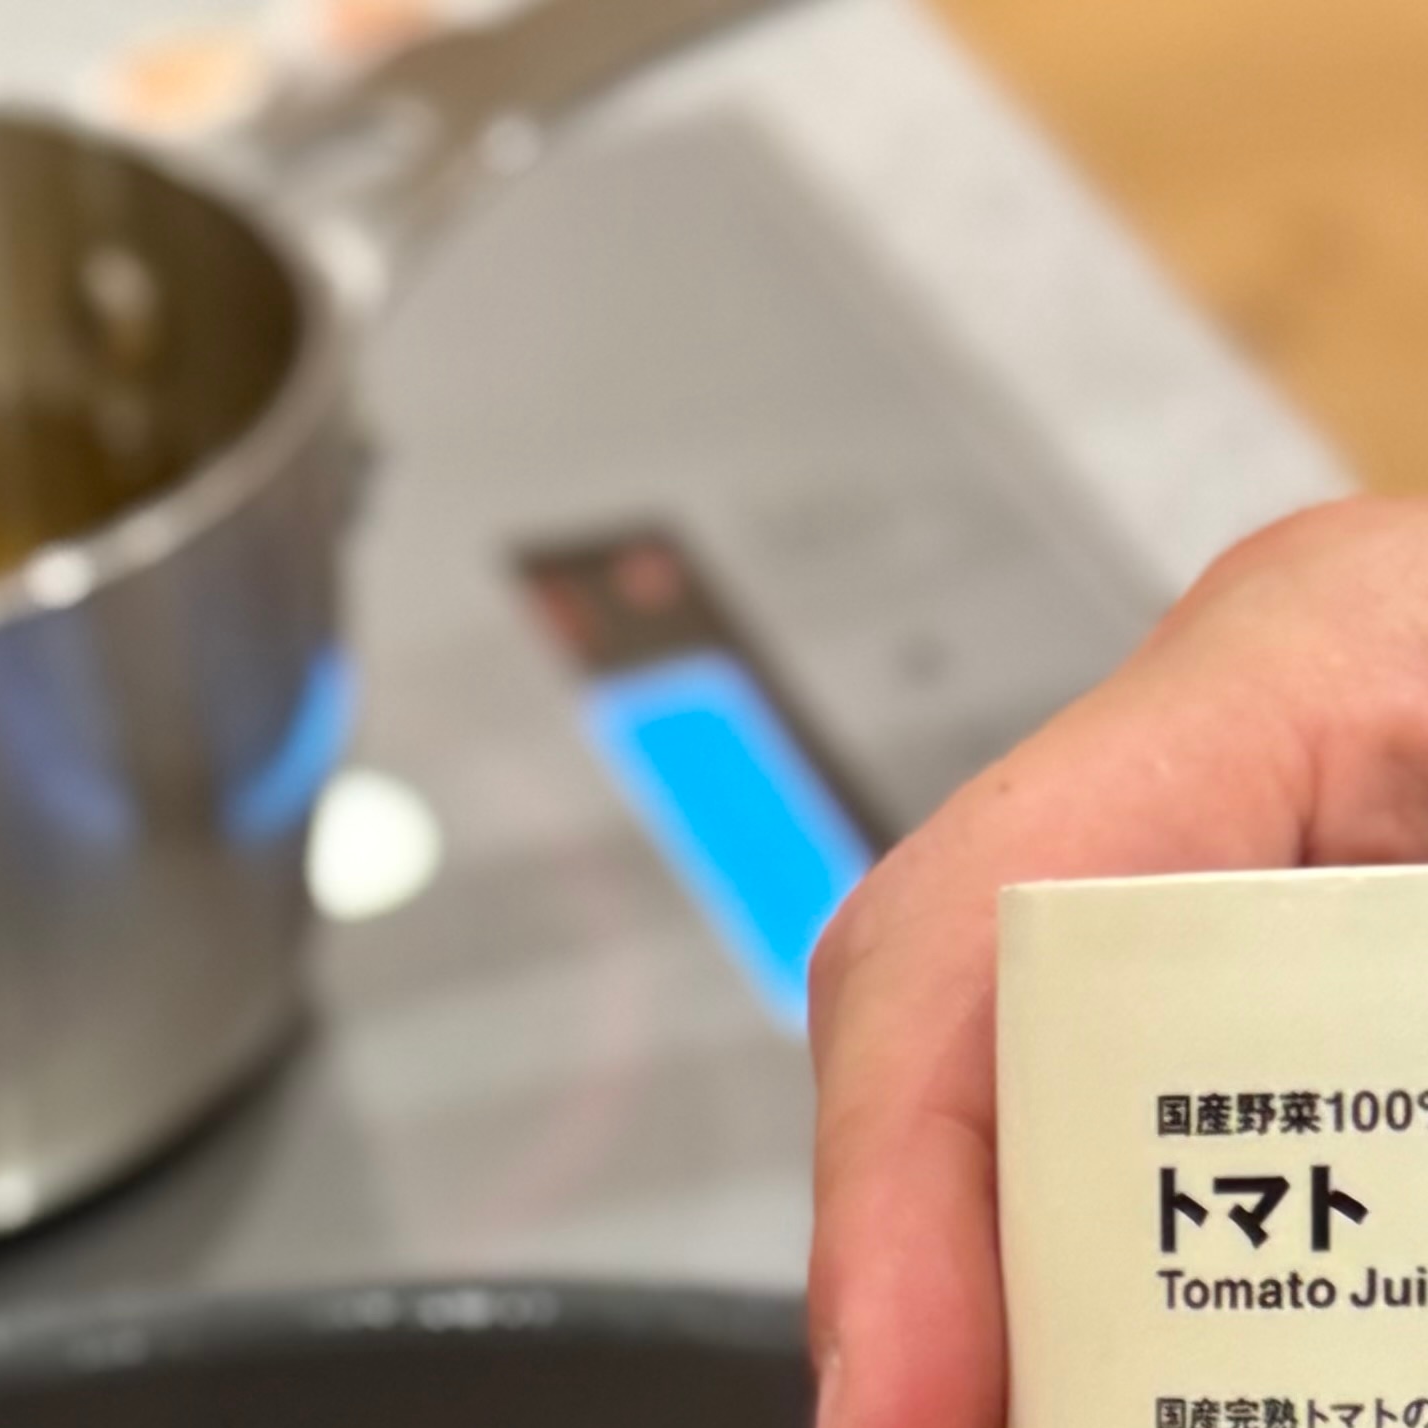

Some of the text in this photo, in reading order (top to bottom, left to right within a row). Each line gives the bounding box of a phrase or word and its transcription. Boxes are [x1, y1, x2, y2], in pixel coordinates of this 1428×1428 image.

[1159, 1165, 1369, 1254] トマト
[1158, 1269, 1336, 1311] Tomato
